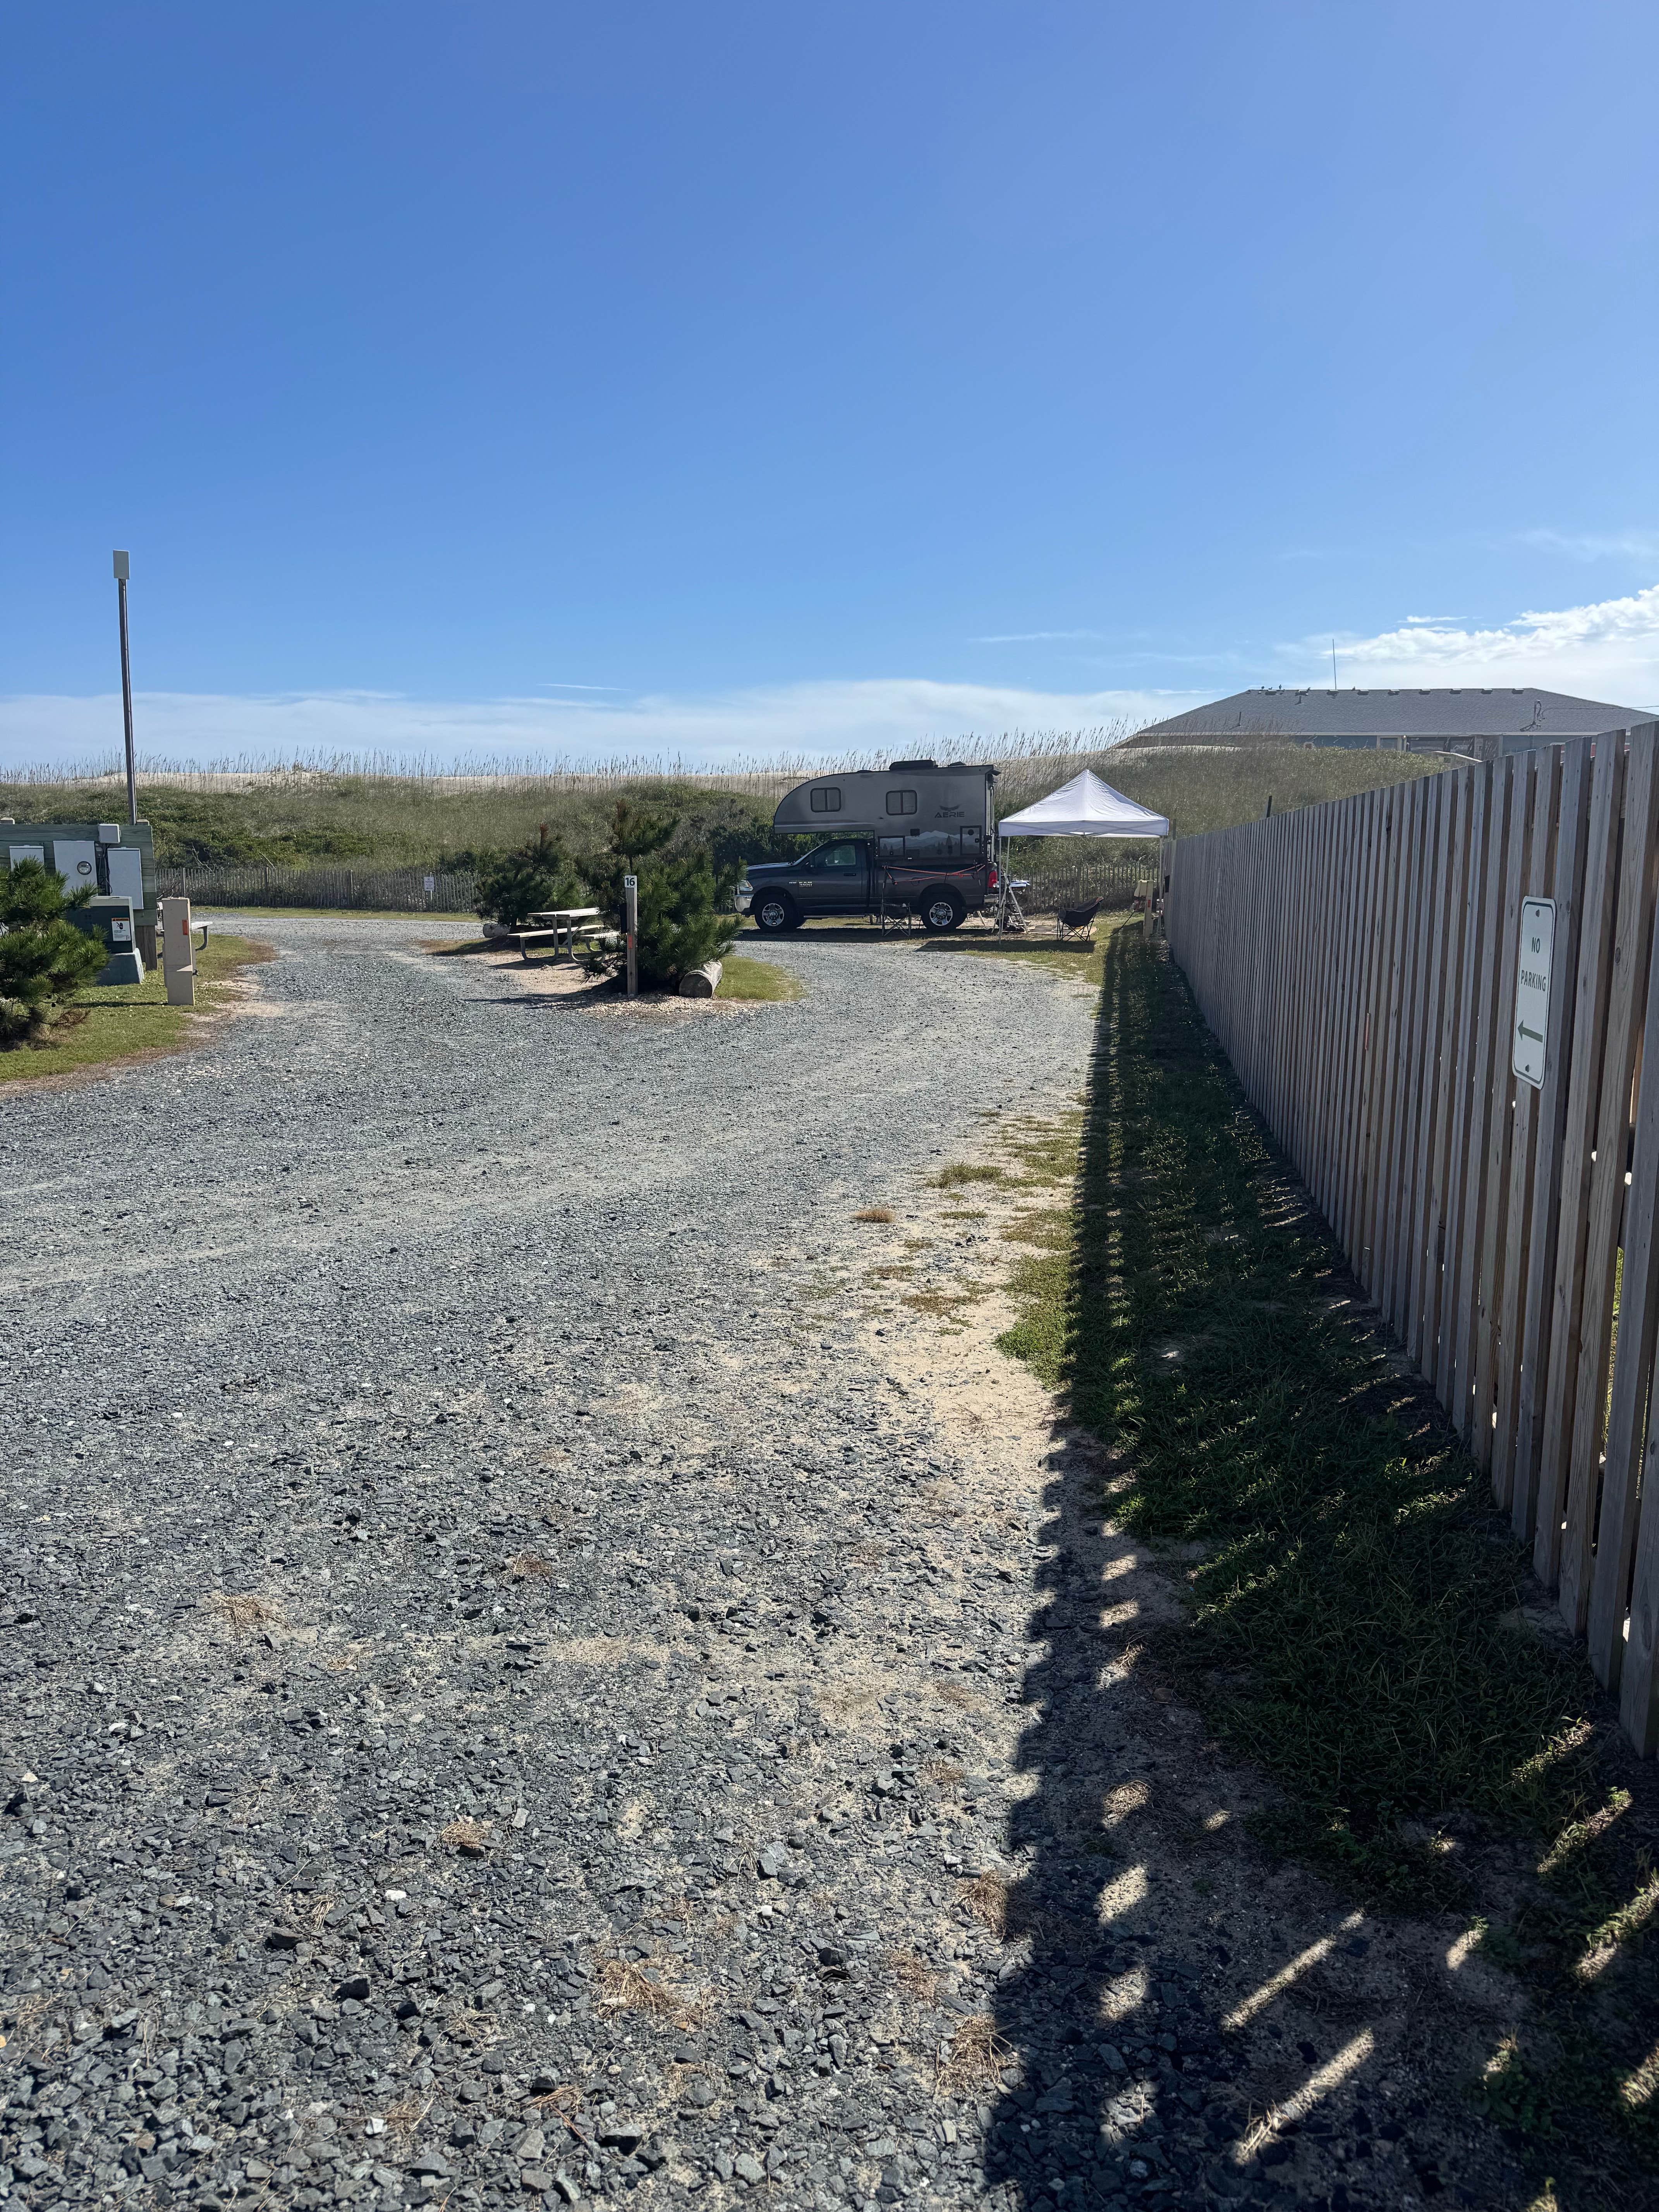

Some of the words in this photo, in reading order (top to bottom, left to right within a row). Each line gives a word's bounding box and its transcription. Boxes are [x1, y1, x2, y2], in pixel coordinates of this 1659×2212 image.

[625, 878, 635, 886] 16
[1532, 937, 1540, 953] NO
[1521, 970, 1546, 991] PARKING
